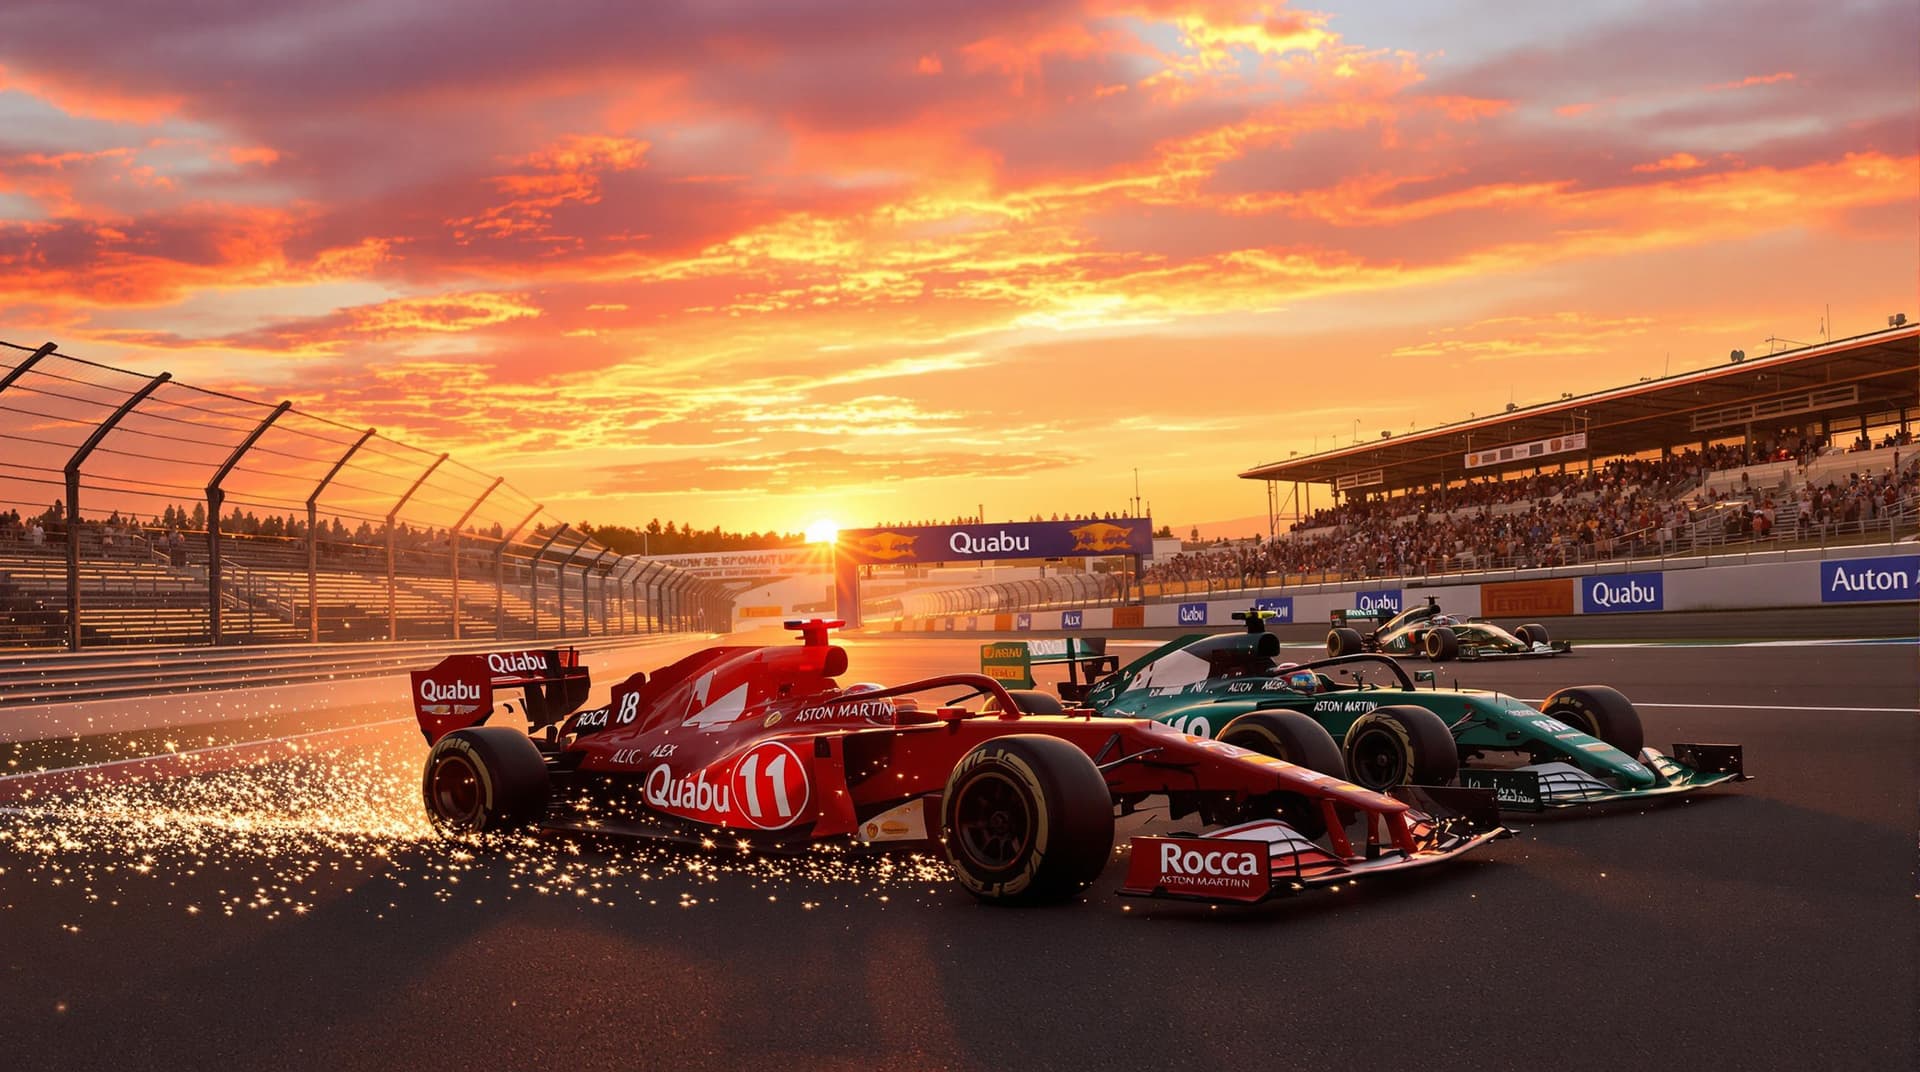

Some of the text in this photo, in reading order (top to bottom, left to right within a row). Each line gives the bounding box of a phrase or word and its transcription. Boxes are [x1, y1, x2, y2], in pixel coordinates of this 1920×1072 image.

[949, 530, 1030, 553] Quabu
[1831, 566, 1908, 592] Auton
[1592, 580, 1655, 606] Quabu
[488, 652, 548, 673] Quabu
[420, 679, 480, 702] Quabu
[576, 710, 609, 728] ROCA
[616, 691, 640, 724] 18
[794, 702, 894, 722] ASTON MARTIN
[646, 763, 730, 813] Quabu
[739, 753, 792, 817] 11
[1160, 842, 1259, 876] Rocca
[1160, 875, 1195, 885] ASTON
